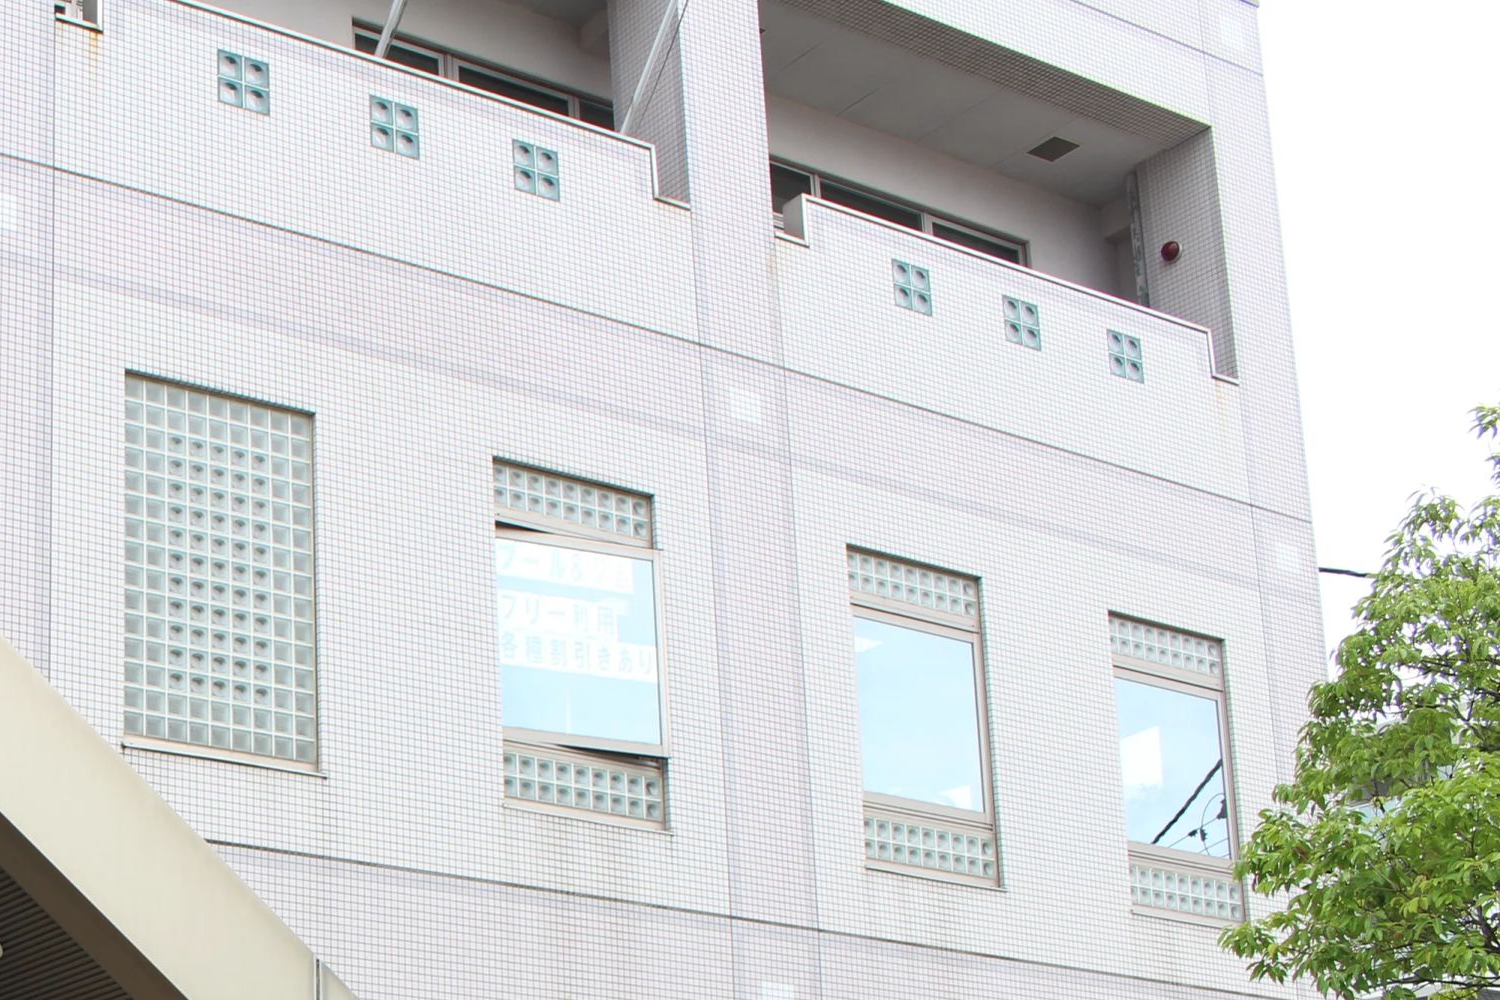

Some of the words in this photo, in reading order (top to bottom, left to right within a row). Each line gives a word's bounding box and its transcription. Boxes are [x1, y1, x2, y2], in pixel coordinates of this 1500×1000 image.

[502, 632, 652, 674] 各種割引きあり
